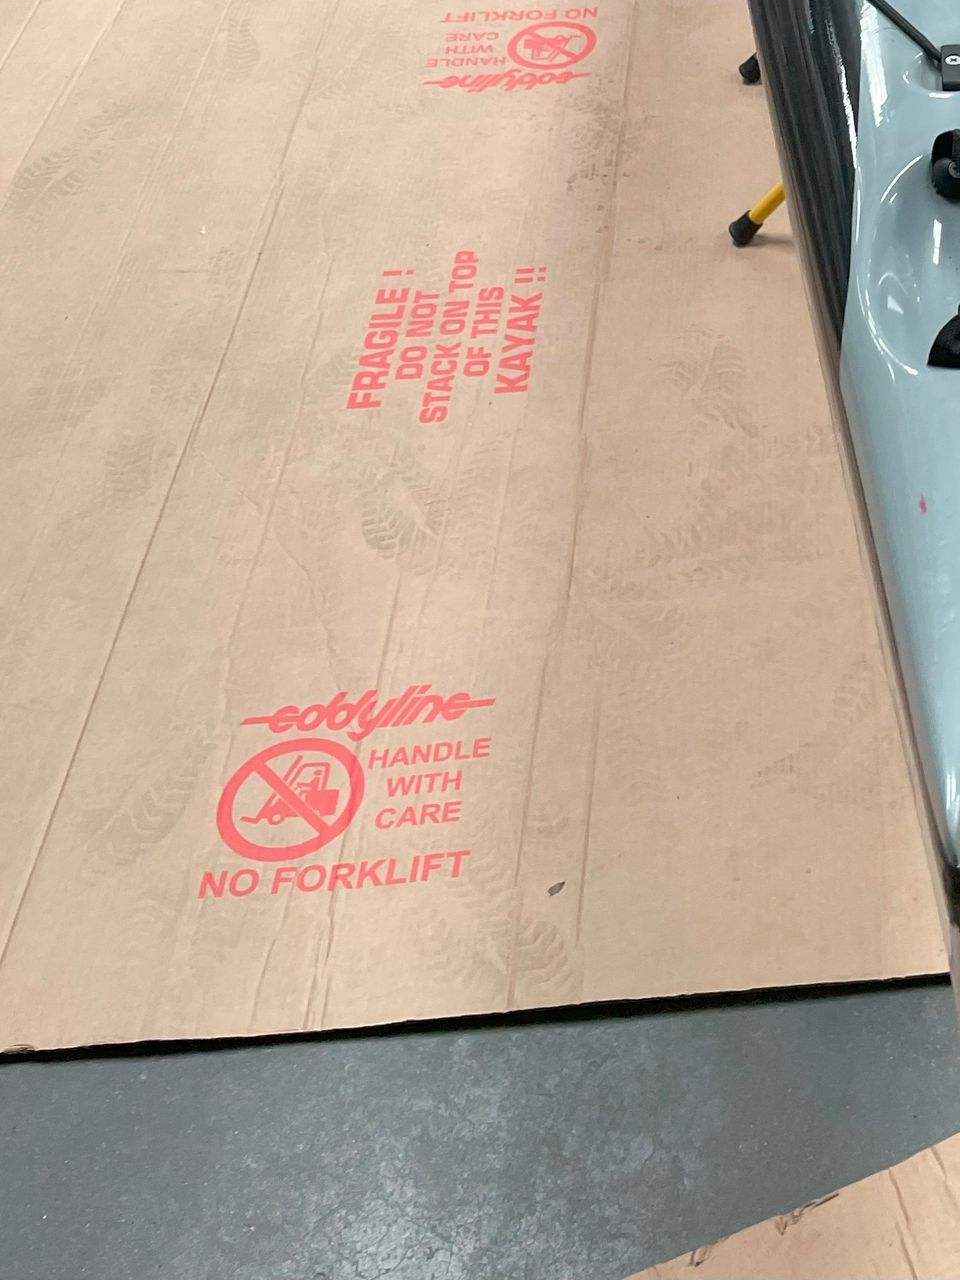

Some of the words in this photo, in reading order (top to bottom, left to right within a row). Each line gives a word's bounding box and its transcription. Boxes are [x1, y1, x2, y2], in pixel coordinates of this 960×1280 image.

[440, 8, 557, 23] FORKLIFT
[565, 7, 598, 19] NO
[445, 31, 499, 42] CARE
[445, 44, 493, 54] WITH
[425, 57, 506, 68] HANDLE
[424, 69, 592, 93] eddyline
[448, 250, 479, 293] TOP
[405, 290, 440, 338] NOT
[439, 300, 471, 335] ON
[470, 286, 505, 339] THIS
[347, 287, 410, 409] FRAGILE
[494, 292, 544, 394] KAYAK
[395, 345, 428, 380] DO
[463, 347, 492, 377] OF
[418, 342, 462, 424] STACK
[240, 684, 496, 742] eddyline
[367, 737, 492, 770] HANDLE
[386, 770, 463, 798] WITH
[375, 801, 463, 829] CARE
[197, 868, 260, 899] NO
[270, 849, 472, 895] FORKLIFT
